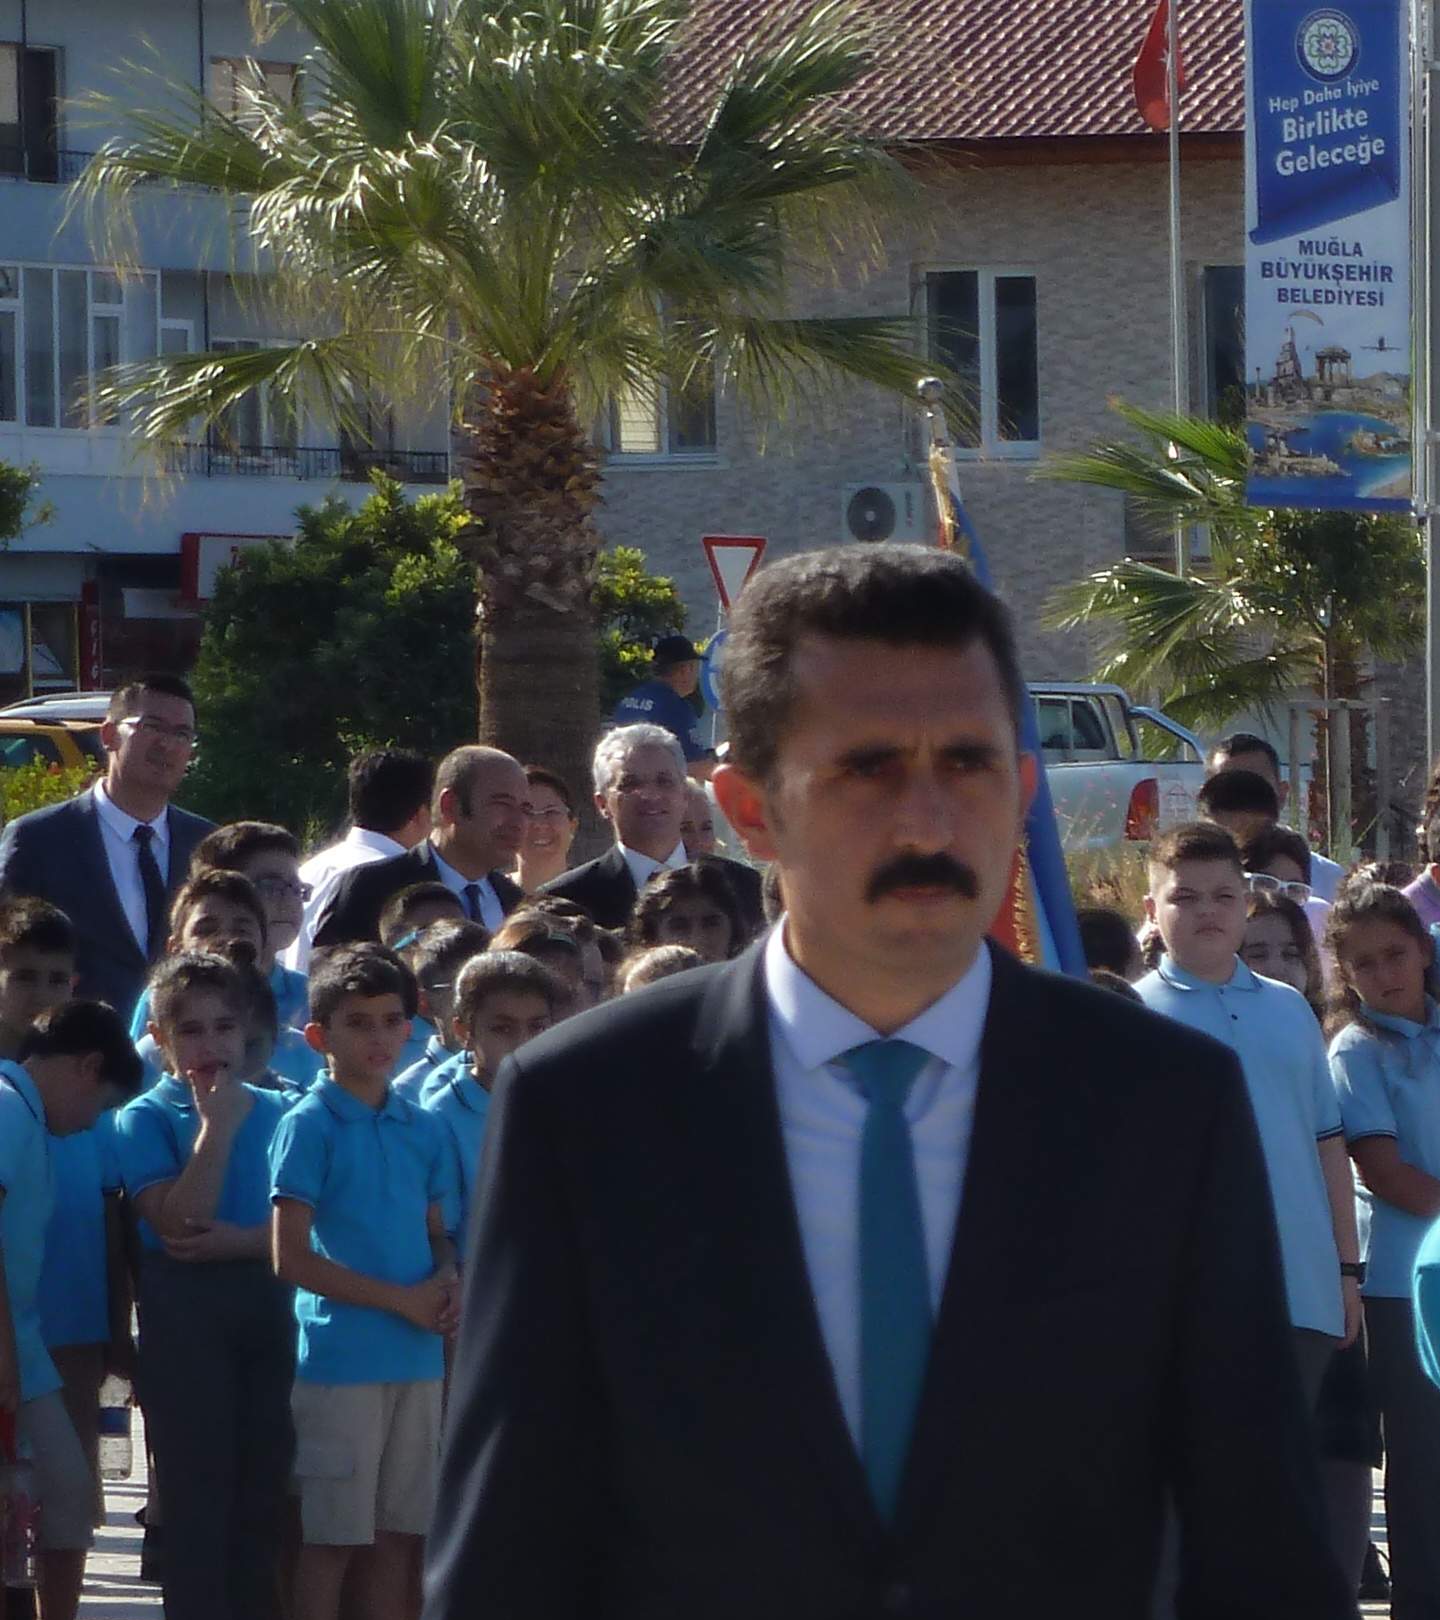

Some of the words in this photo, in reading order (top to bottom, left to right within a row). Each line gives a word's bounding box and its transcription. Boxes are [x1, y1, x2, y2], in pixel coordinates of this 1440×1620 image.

[1269, 97, 1298, 113] Hep
[1303, 86, 1342, 105] Daha
[1282, 107, 1368, 143] Birlikte
[1275, 134, 1385, 176] Geleceğe
[1298, 236, 1364, 258] MUĞLA
[1260, 257, 1394, 287] BÜYÜKŞEHİR
[1276, 287, 1385, 307] BELEDİYESİ
